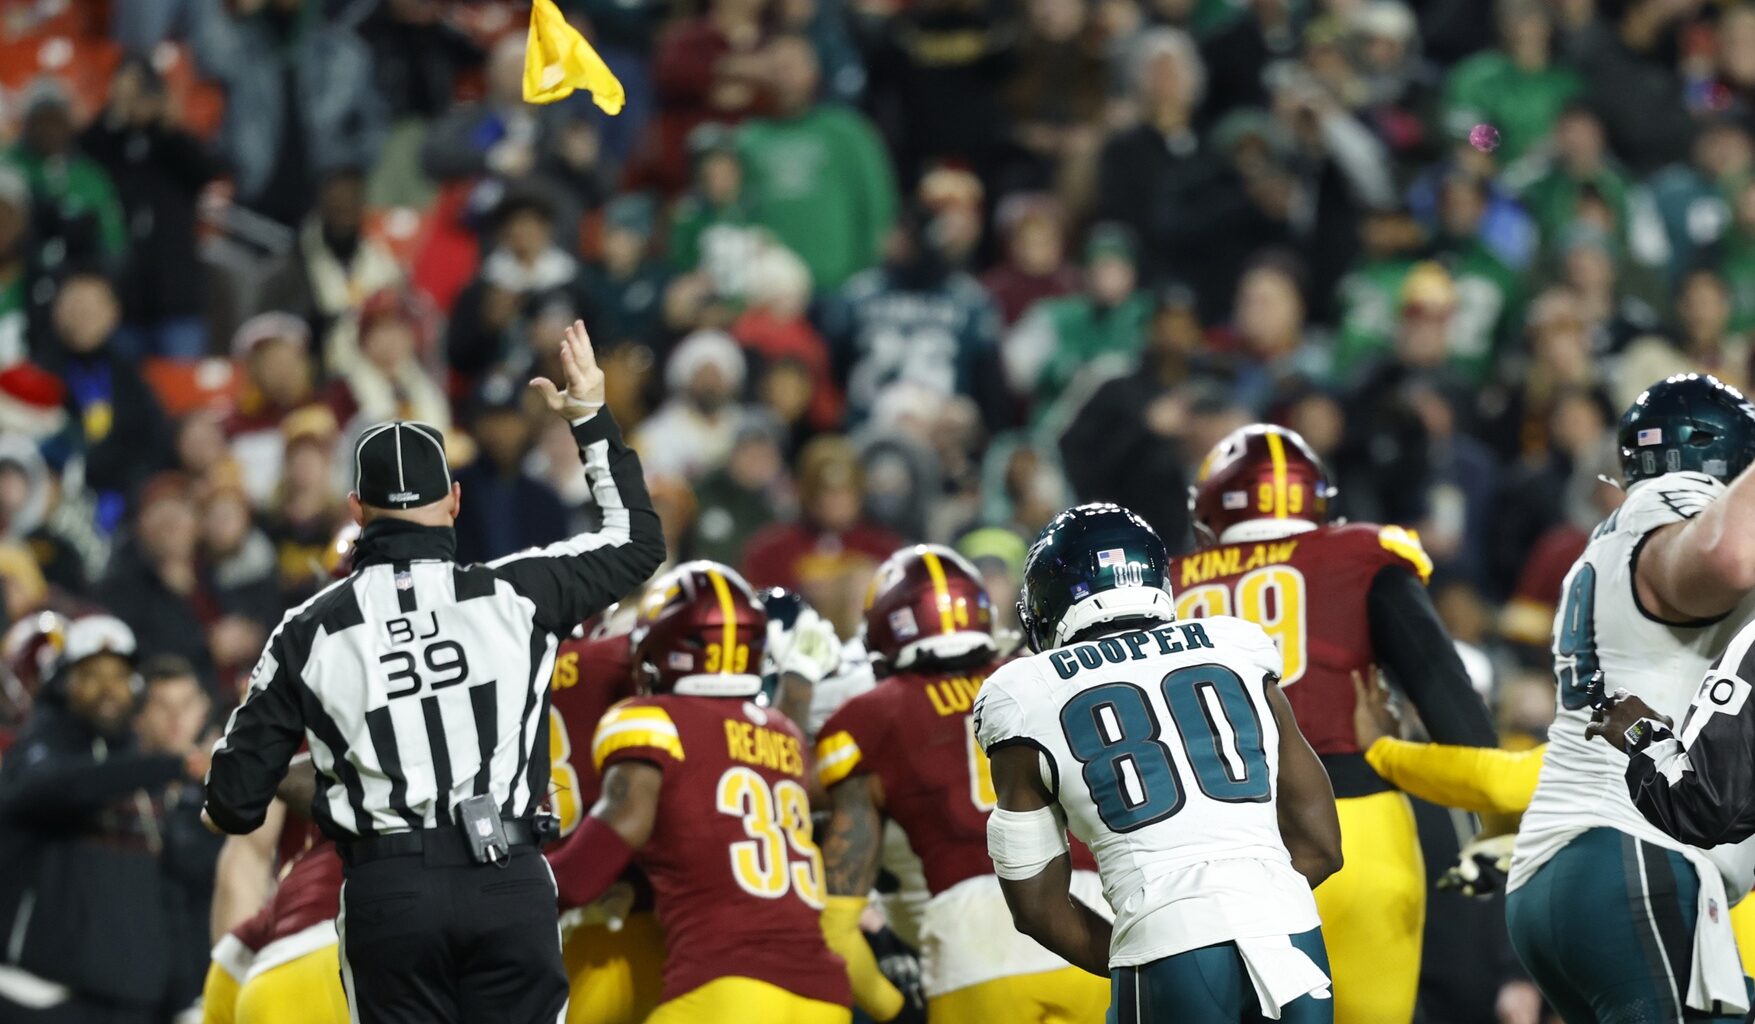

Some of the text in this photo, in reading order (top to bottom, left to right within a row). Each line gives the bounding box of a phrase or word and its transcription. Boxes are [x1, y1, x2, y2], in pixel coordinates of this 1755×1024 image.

[1641, 449, 1681, 475] 69
[1258, 482, 1303, 513] 99
[1113, 561, 1143, 589] 80
[1181, 541, 1298, 587] KINLAW
[386, 611, 439, 646] BJ
[1048, 622, 1215, 680] COOPER
[379, 640, 469, 700] 39
[704, 643, 750, 674] 39
[724, 719, 804, 777] REAVES
[1059, 663, 1271, 834] 80
[716, 766, 829, 911] 39
